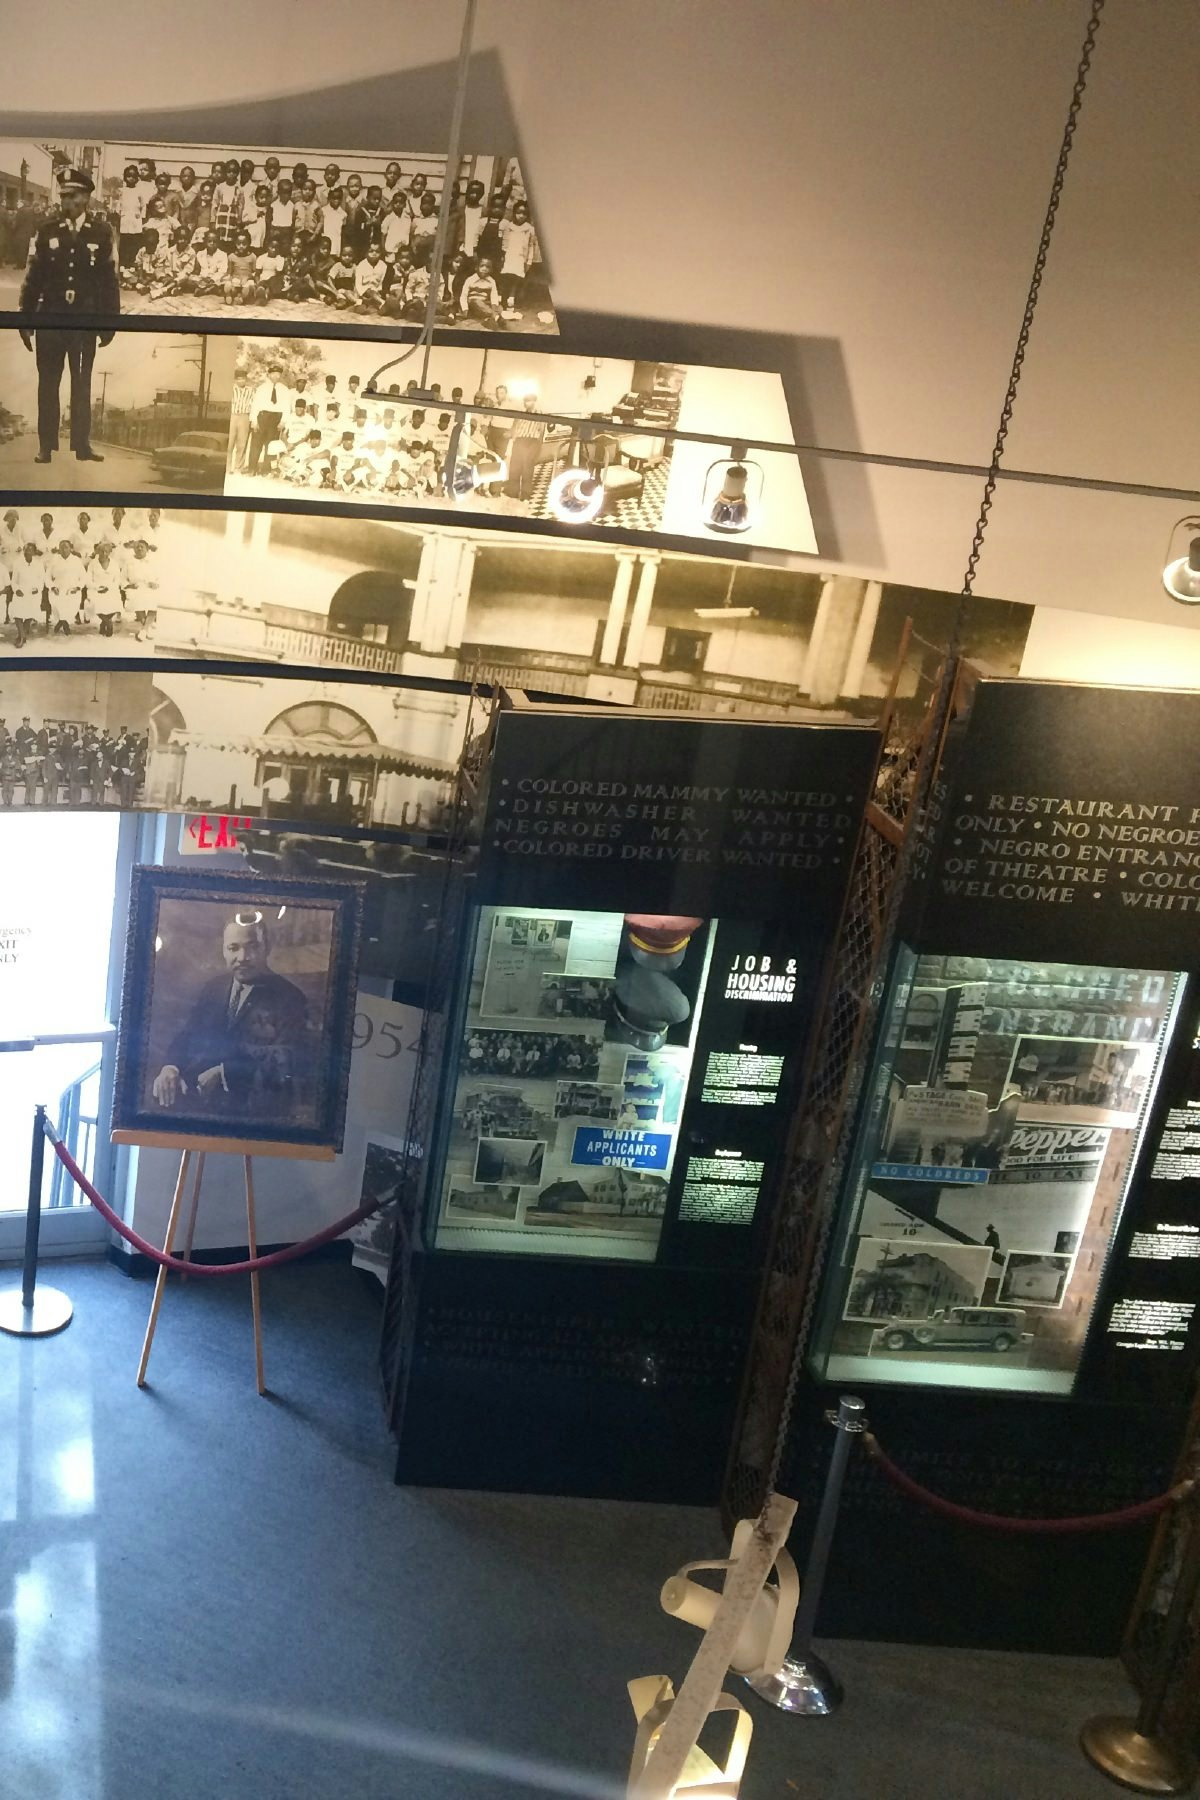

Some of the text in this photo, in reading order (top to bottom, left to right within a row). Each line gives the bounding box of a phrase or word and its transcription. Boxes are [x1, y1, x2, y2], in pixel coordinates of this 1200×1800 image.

[517, 777, 837, 808] COLORED MAMMY WANTED
[513, 798, 852, 830] DISHWASHER WANTED
[988, 795, 1179, 823] RESTAURANT
[495, 818, 832, 848] NEGROES MAY APPLY
[955, 815, 1025, 833] ONLY
[1051, 820, 1090, 839] NO
[502, 839, 823, 869] COLORED DRIVER WANTED
[980, 839, 1071, 859] NEGRO
[944, 858, 977, 874] OF
[985, 860, 1108, 884] THEATRE
[942, 879, 1075, 904] WELCOME
[731, 954, 798, 975] JOB &
[726, 973, 797, 994] HOUSING
[724, 989, 794, 1003] DISCRIMINATION
[602, 1130, 645, 1142] WHITE
[586, 1141, 657, 1157] APPLICANTS
[601, 1155, 636, 1168] ONLY
[880, 1166, 899, 1176] NO
